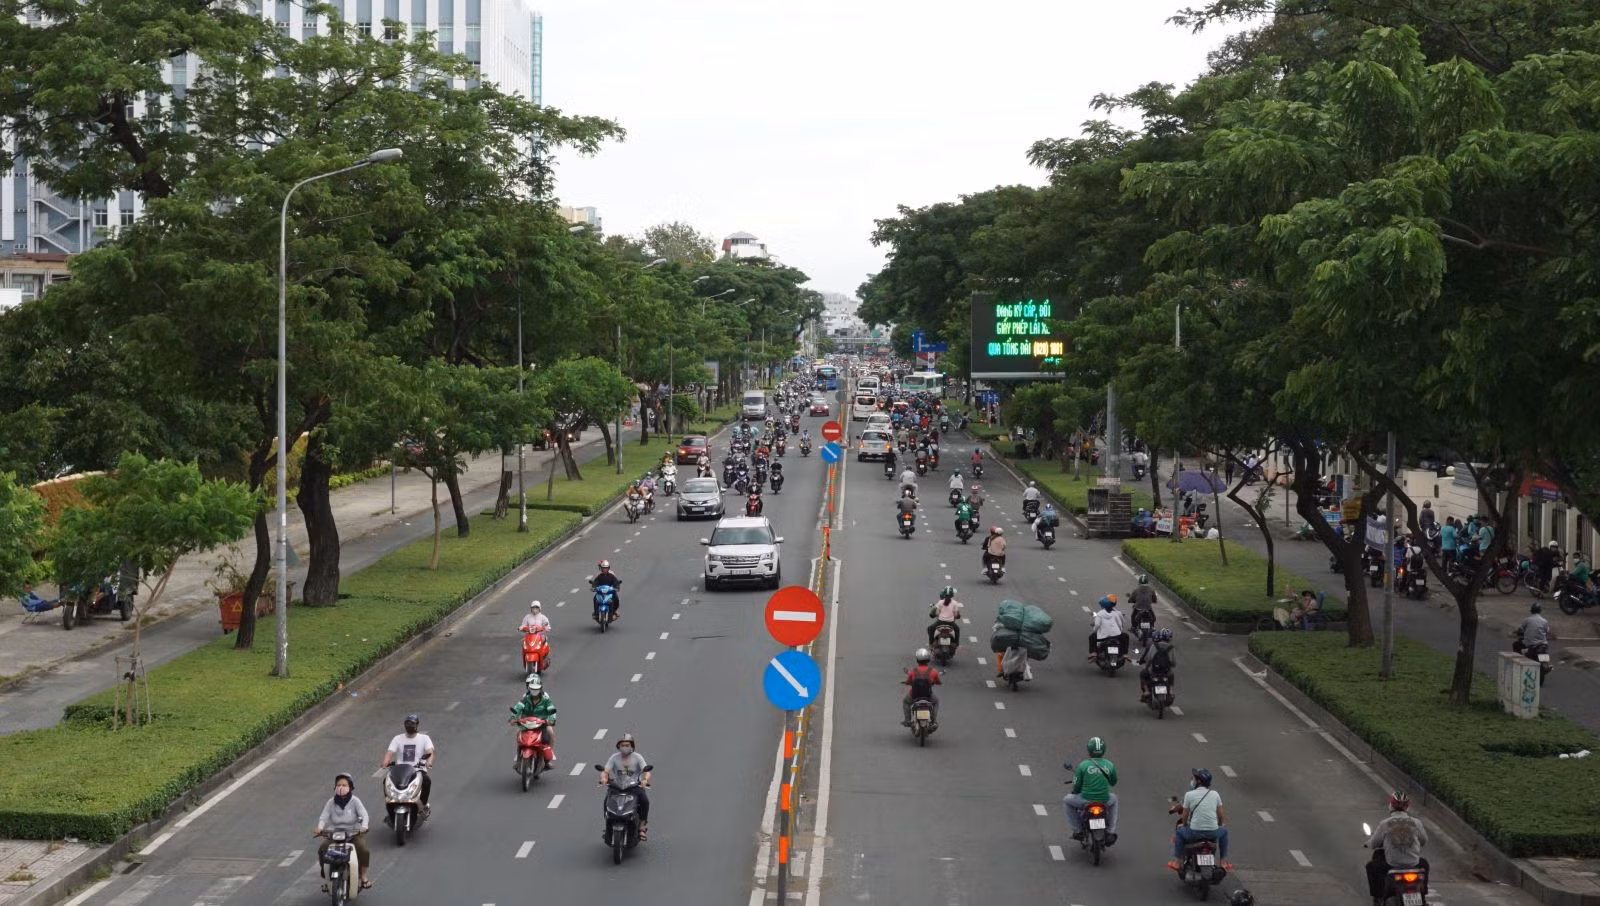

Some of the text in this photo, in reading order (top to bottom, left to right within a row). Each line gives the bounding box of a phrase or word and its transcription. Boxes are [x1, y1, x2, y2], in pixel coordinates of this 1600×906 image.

[1013, 302, 1022, 317] KÝ
[1039, 299, 1051, 317] ĐỔI
[996, 317, 1011, 334] GIẤY
[1012, 319, 1028, 334] PHÉP
[1029, 317, 1041, 334] LÁI
[988, 342, 1001, 356] QUA
[1002, 338, 1019, 355] TỔNG
[1020, 340, 1031, 355] ĐÀI
